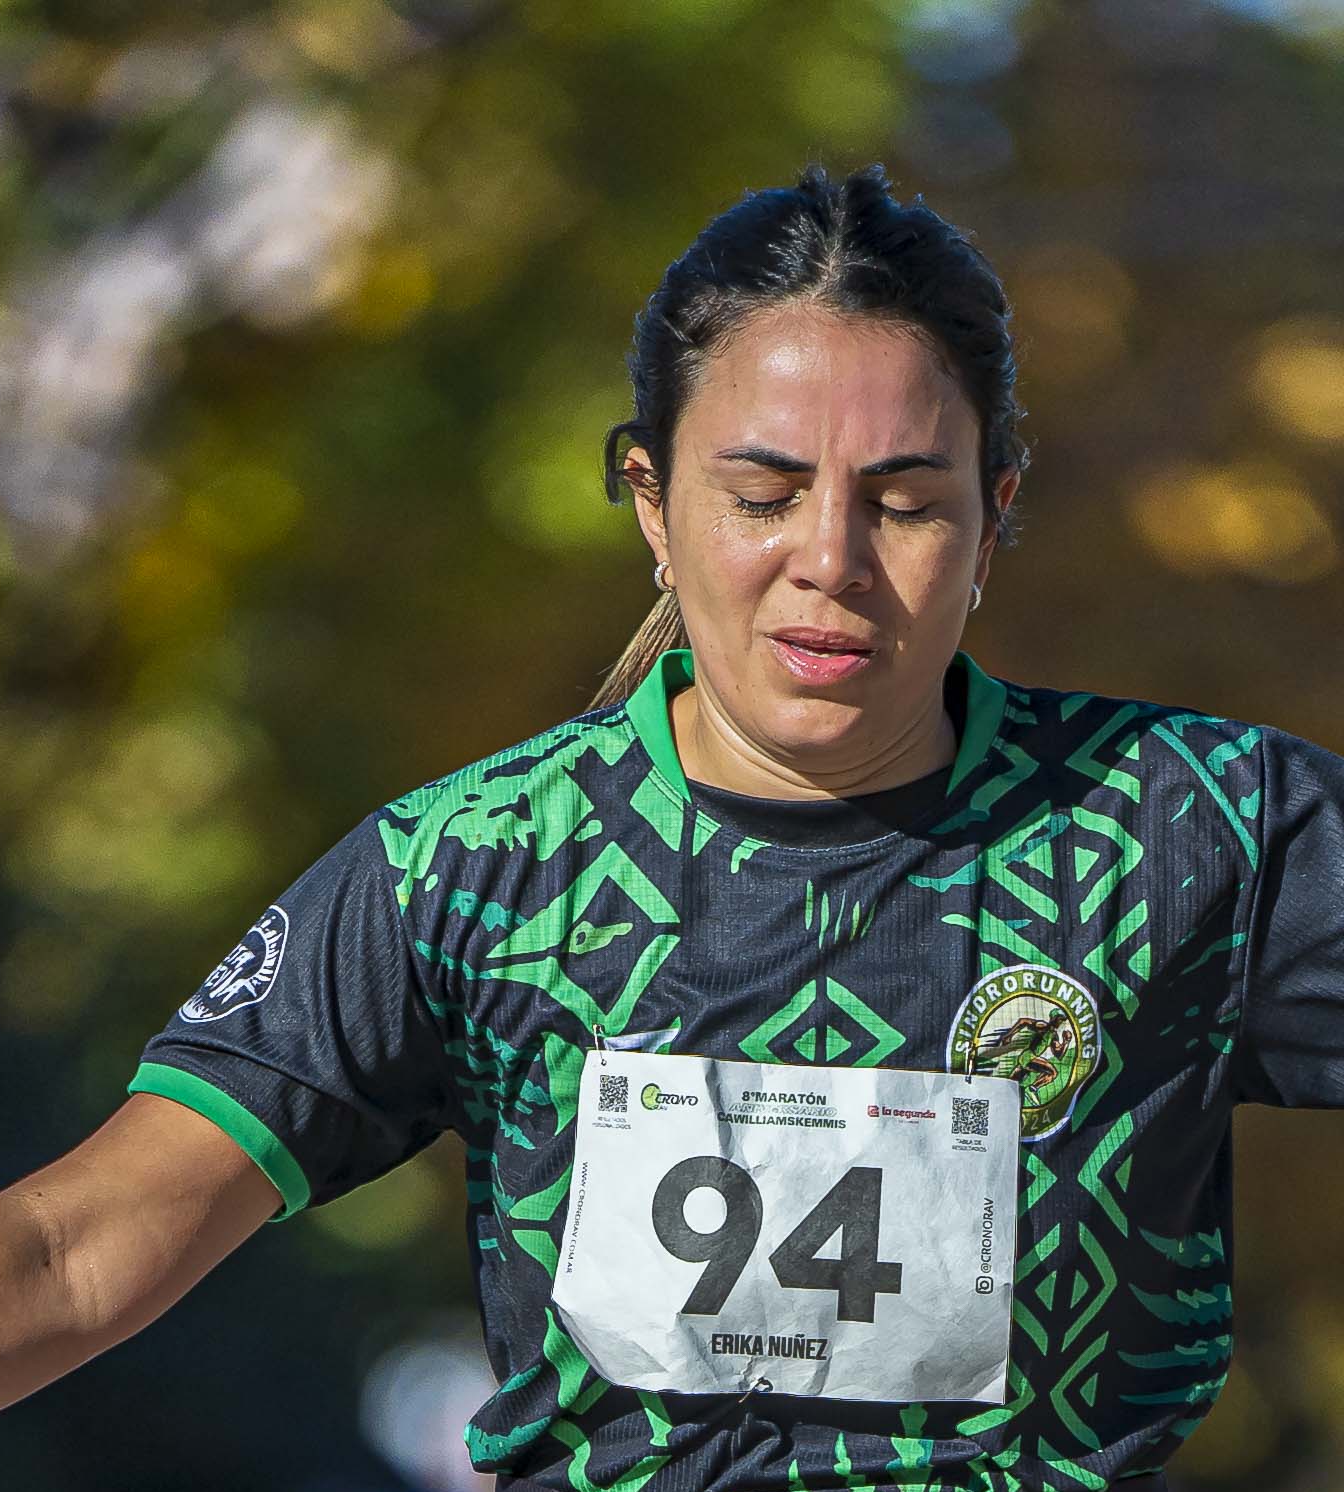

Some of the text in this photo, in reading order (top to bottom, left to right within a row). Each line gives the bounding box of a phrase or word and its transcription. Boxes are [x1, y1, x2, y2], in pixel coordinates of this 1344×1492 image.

[955, 972, 1096, 1059] SINDRORUNNING
[882, 1106, 936, 1119] la segunda
[652, 1155, 903, 1323] 94
[981, 1197, 994, 1273] @CRONORAV
[711, 1333, 828, 1361] ERIKA NUÑEZ
